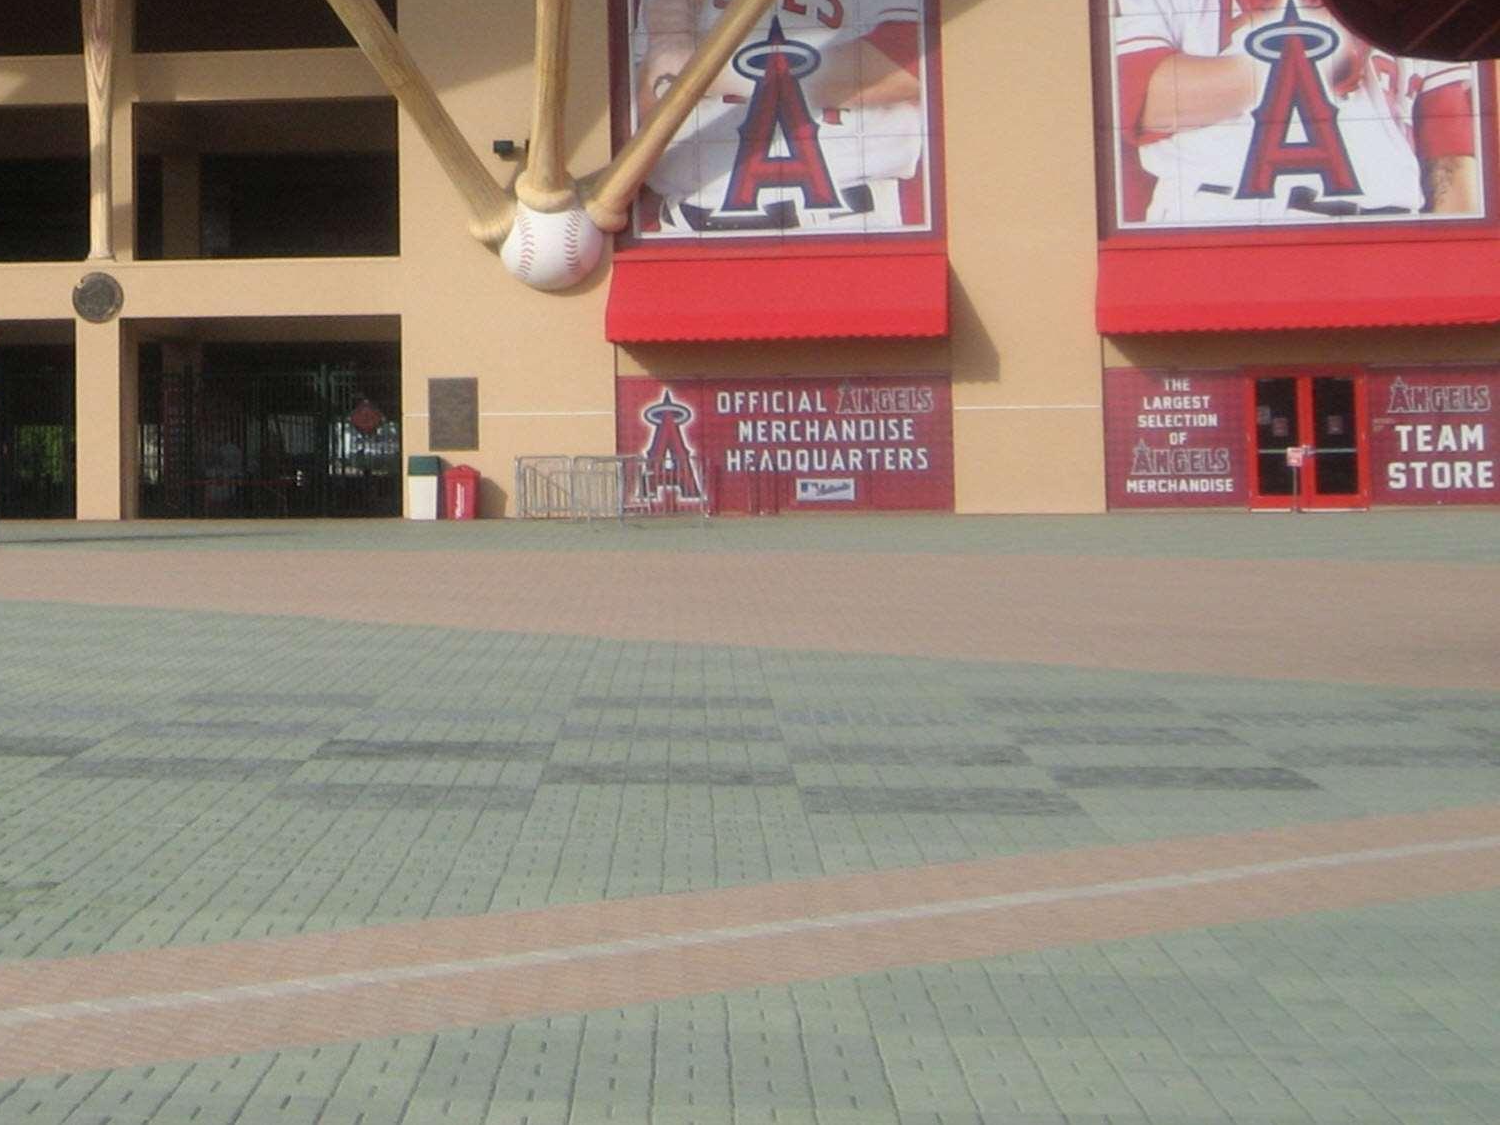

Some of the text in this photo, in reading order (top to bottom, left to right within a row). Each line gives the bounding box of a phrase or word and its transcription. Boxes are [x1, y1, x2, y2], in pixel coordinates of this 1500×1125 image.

[1164, 379, 1191, 391] THE
[1387, 375, 1492, 413] ANGELS
[716, 382, 935, 415] OFFICIAL ANGELS
[1143, 396, 1211, 410] LARGEST
[738, 418, 915, 443] MERCHANDISE
[1137, 414, 1218, 428] SELECTION
[1169, 432, 1188, 445] OF
[1394, 424, 1485, 452] TEAM
[726, 447, 929, 472] HEADQUARTERS
[1130, 437, 1231, 475] ANGELS
[1126, 478, 1234, 493] MERCHANDISE
[1387, 460, 1495, 489] STORE
